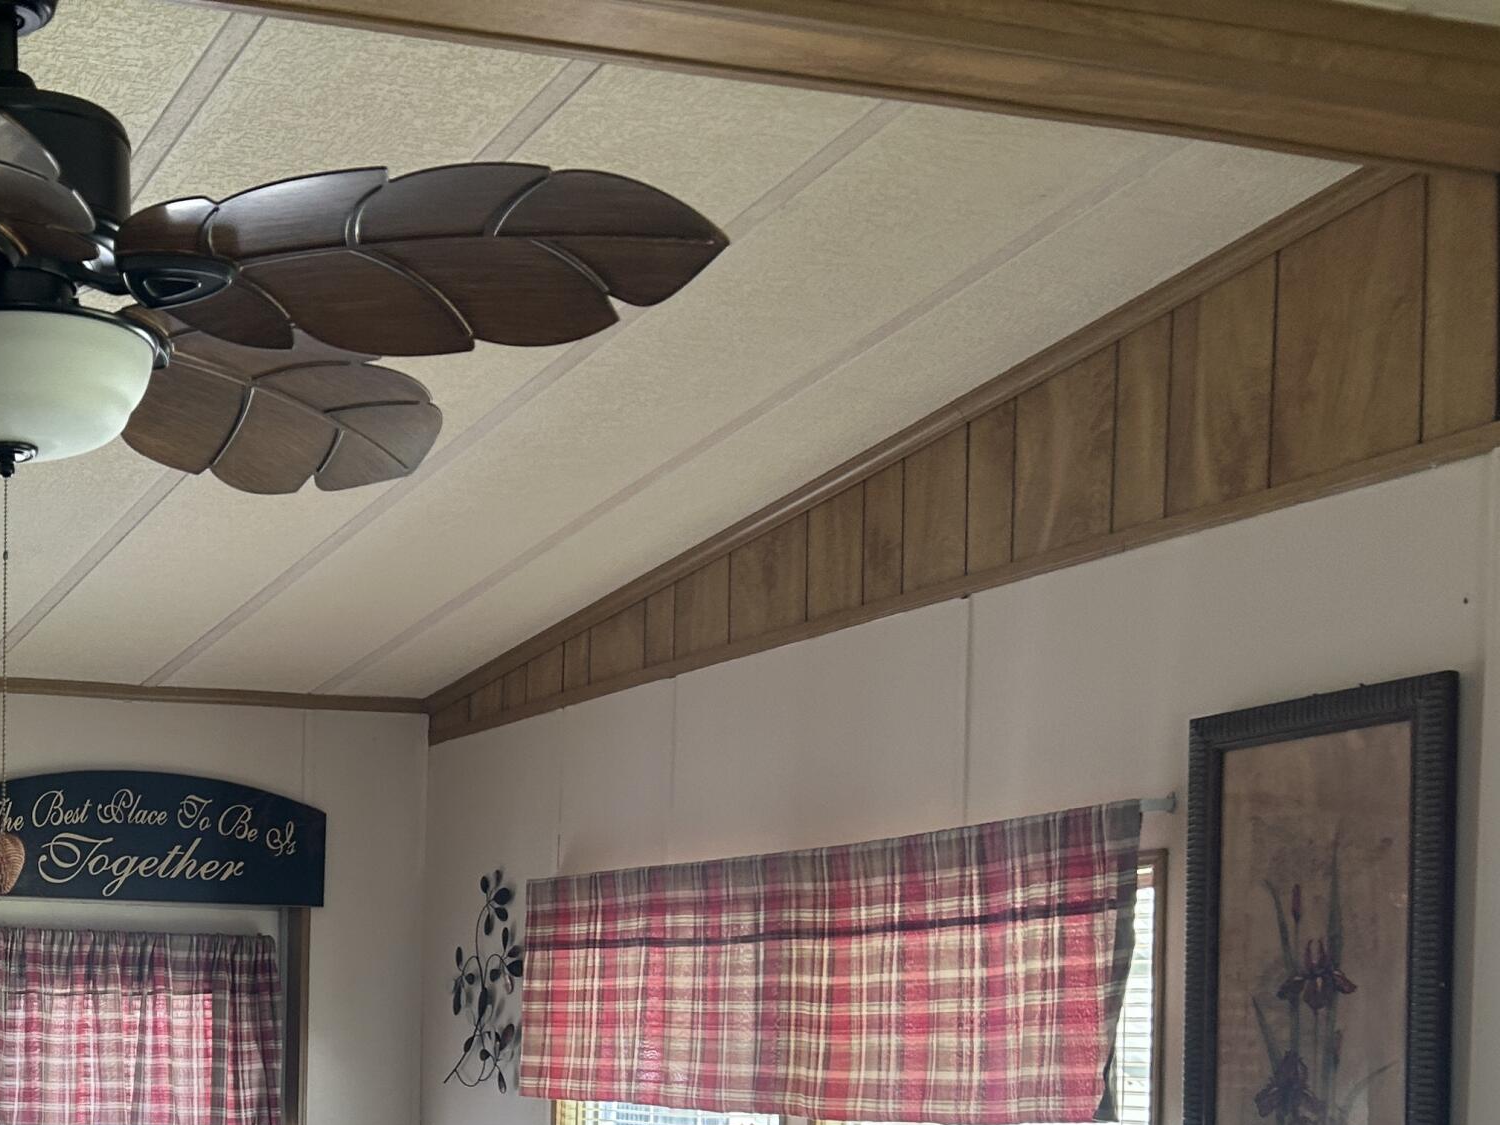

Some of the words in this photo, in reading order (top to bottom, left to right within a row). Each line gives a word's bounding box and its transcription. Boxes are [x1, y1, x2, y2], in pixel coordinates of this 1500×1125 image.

[32, 790, 91, 828] Best
[97, 788, 168, 826] Place
[178, 794, 211, 830] To
[218, 804, 259, 842] Be
[266, 821, 298, 857] Is
[37, 831, 245, 897] Together
